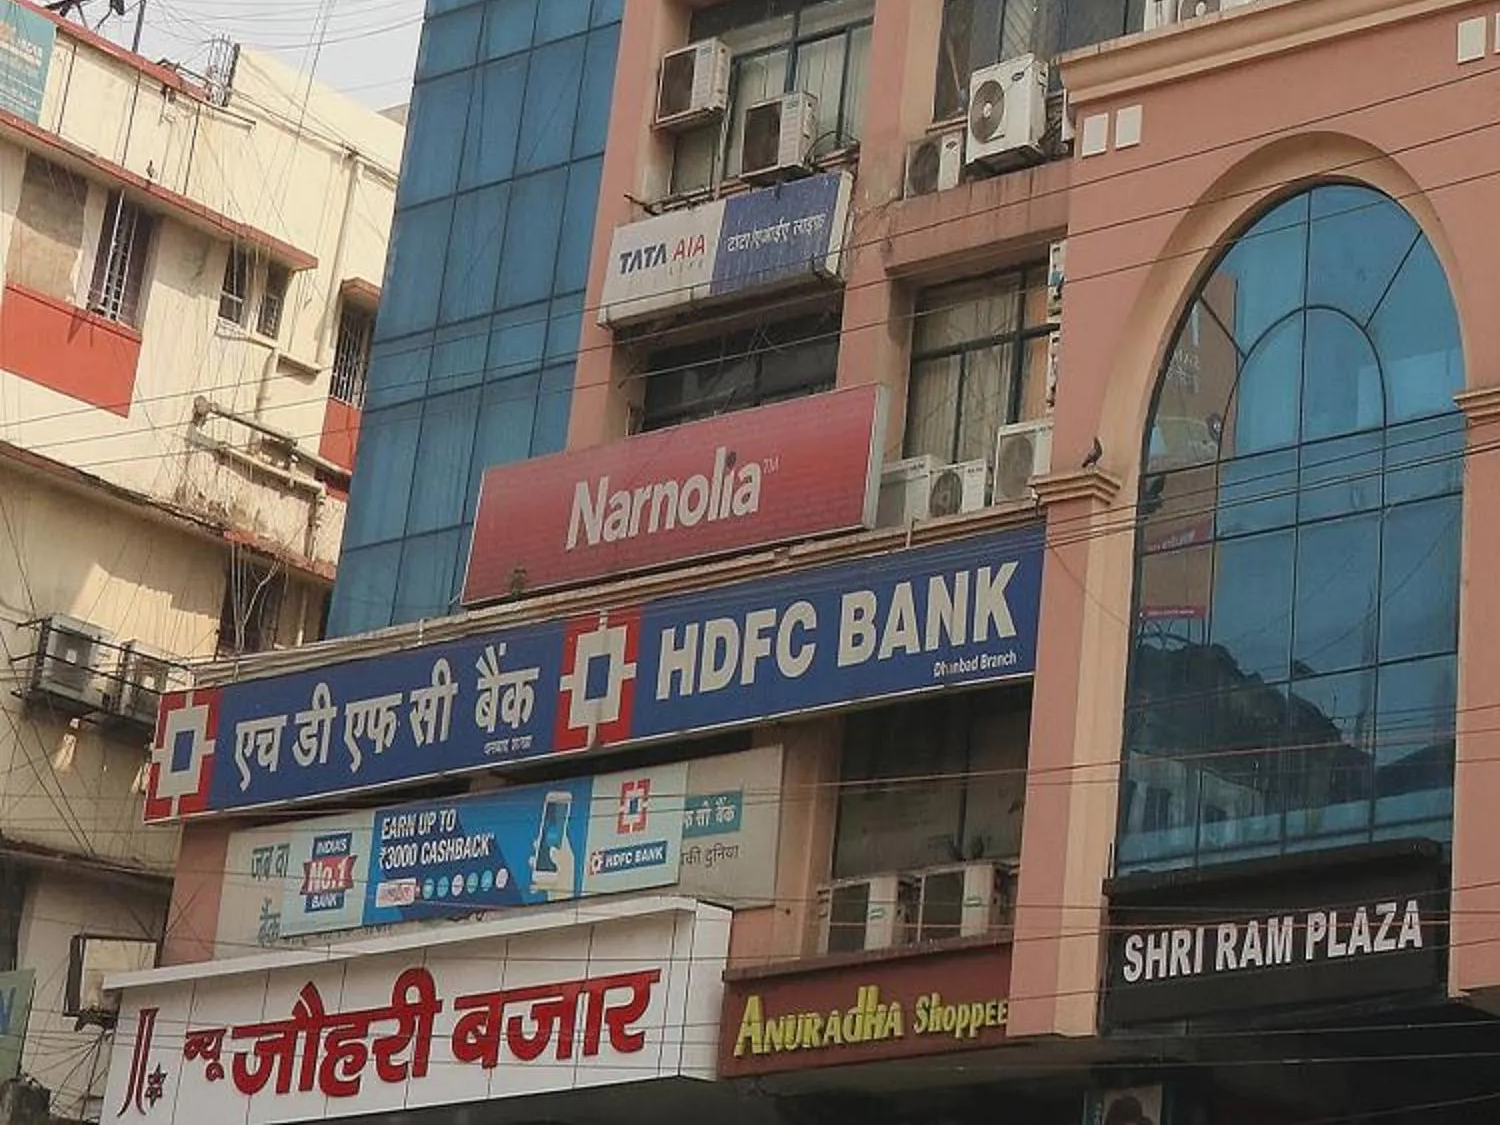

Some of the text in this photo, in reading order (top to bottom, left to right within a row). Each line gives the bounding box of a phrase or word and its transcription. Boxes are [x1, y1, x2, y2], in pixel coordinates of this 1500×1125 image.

[619, 242, 667, 276] TATA
[671, 234, 707, 262] AIA
[564, 445, 763, 551] Narnolia
[655, 560, 1020, 701] HDFC BANK
[934, 648, 1017, 678] Dhanbad Branch
[233, 641, 540, 793] एच डी एफ सी बैंक
[380, 808, 457, 840] EARN UP TO
[308, 857, 348, 892] No.1
[605, 846, 666, 868] HDFC BANK
[310, 893, 338, 909] BANK
[1123, 899, 1424, 983] SHRI RAM PLAZA
[182, 1025, 232, 1084] न्यू
[452, 967, 662, 1070] बजार
